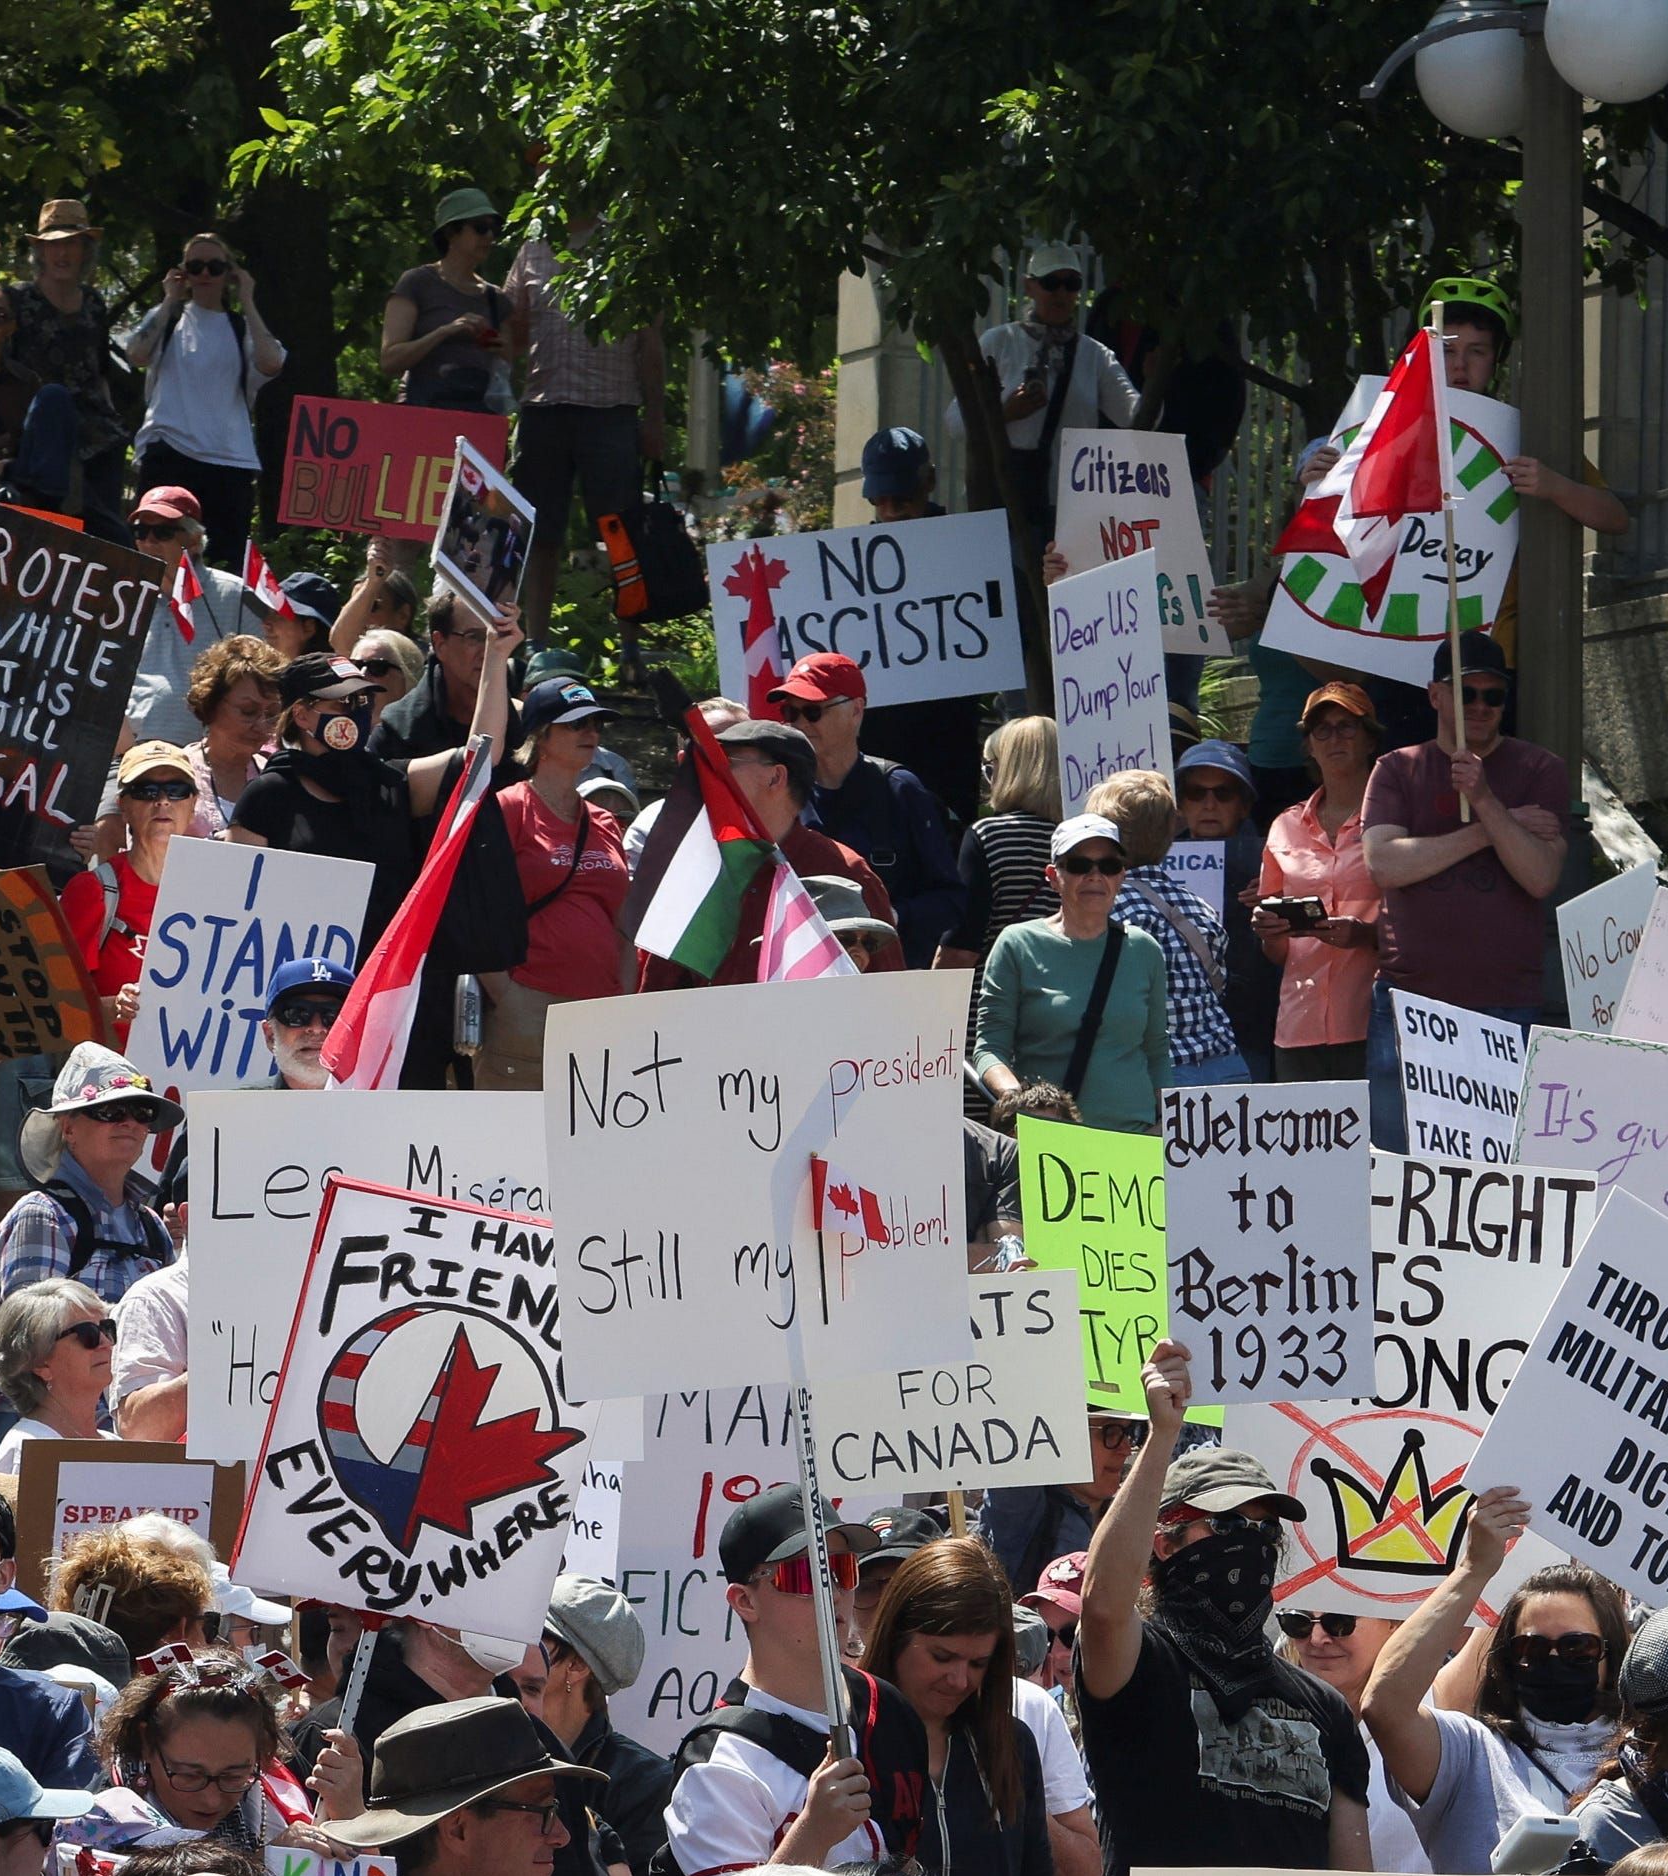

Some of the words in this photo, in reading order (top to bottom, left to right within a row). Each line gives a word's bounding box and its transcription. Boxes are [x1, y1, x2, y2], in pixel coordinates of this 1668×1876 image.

[294, 406, 359, 459] NO
[1071, 446, 1171, 500] Citizens
[818, 534, 905, 599] NO
[1054, 606, 1105, 656] Dear
[1062, 674, 1122, 727] Dump
[1119, 655, 1161, 710] Your
[244, 854, 265, 911] I
[1566, 938, 1599, 988] No
[1405, 1005, 1459, 1045] STOP
[1480, 1028, 1519, 1064] THE
[1591, 1000, 1616, 1033] for
[569, 1031, 683, 1136] Not
[718, 1068, 782, 1152] my
[830, 1030, 959, 1137] president,
[1534, 1083, 1597, 1143] It's
[1165, 1092, 1361, 1168] Welcome
[1416, 1120, 1473, 1160] TAKE
[405, 1206, 445, 1239] I
[1228, 1172, 1294, 1234] to
[578, 1232, 683, 1313] Still
[733, 1245, 795, 1330] my
[1082, 1243, 1156, 1292] DIES
[1168, 1244, 1361, 1323] Berlin
[896, 1364, 997, 1410] FOR
[1208, 1324, 1348, 1393] 1933
[832, 1418, 1062, 1483] CANADA
[1546, 1475, 1622, 1547] AND
